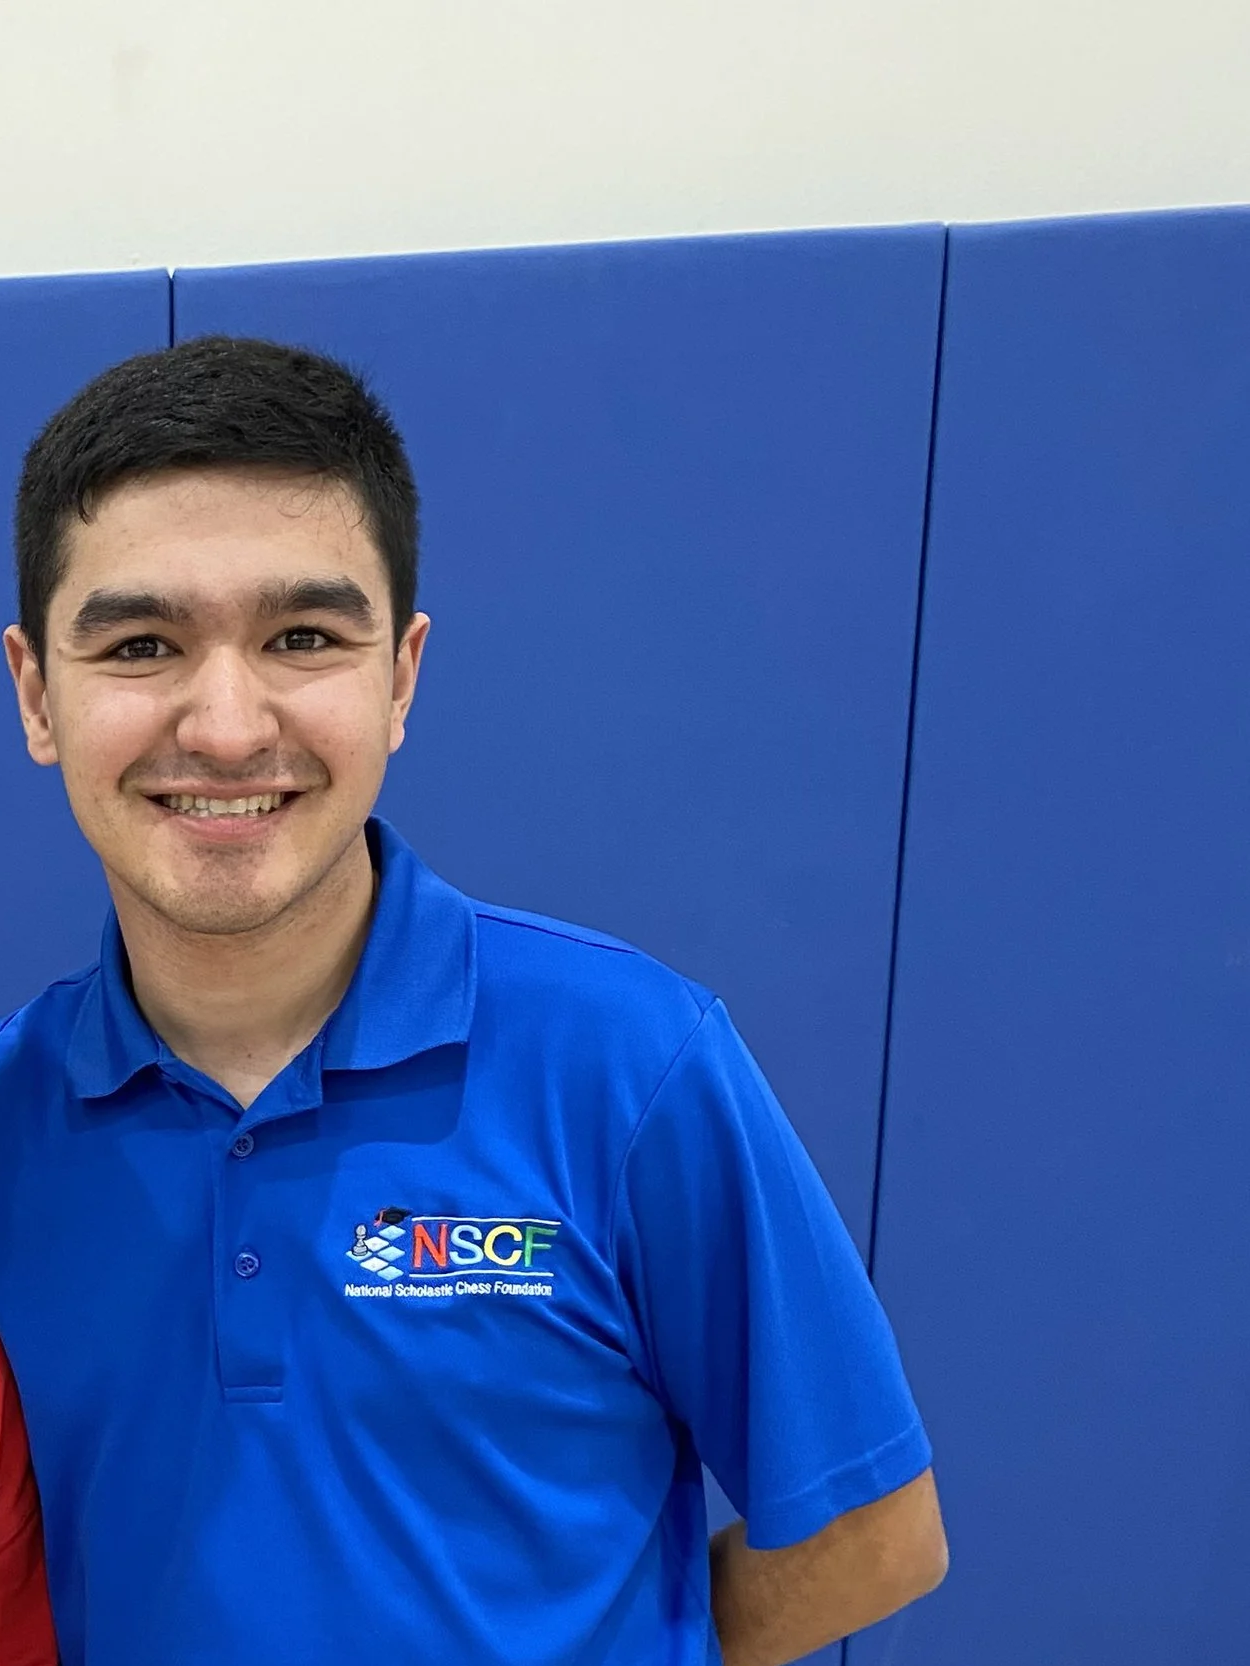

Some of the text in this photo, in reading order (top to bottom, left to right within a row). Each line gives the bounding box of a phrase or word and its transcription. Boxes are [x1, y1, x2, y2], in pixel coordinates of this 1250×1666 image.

[412, 1222, 558, 1268] NSCF
[345, 1281, 552, 1298] National Scholastic Chess Foundation
